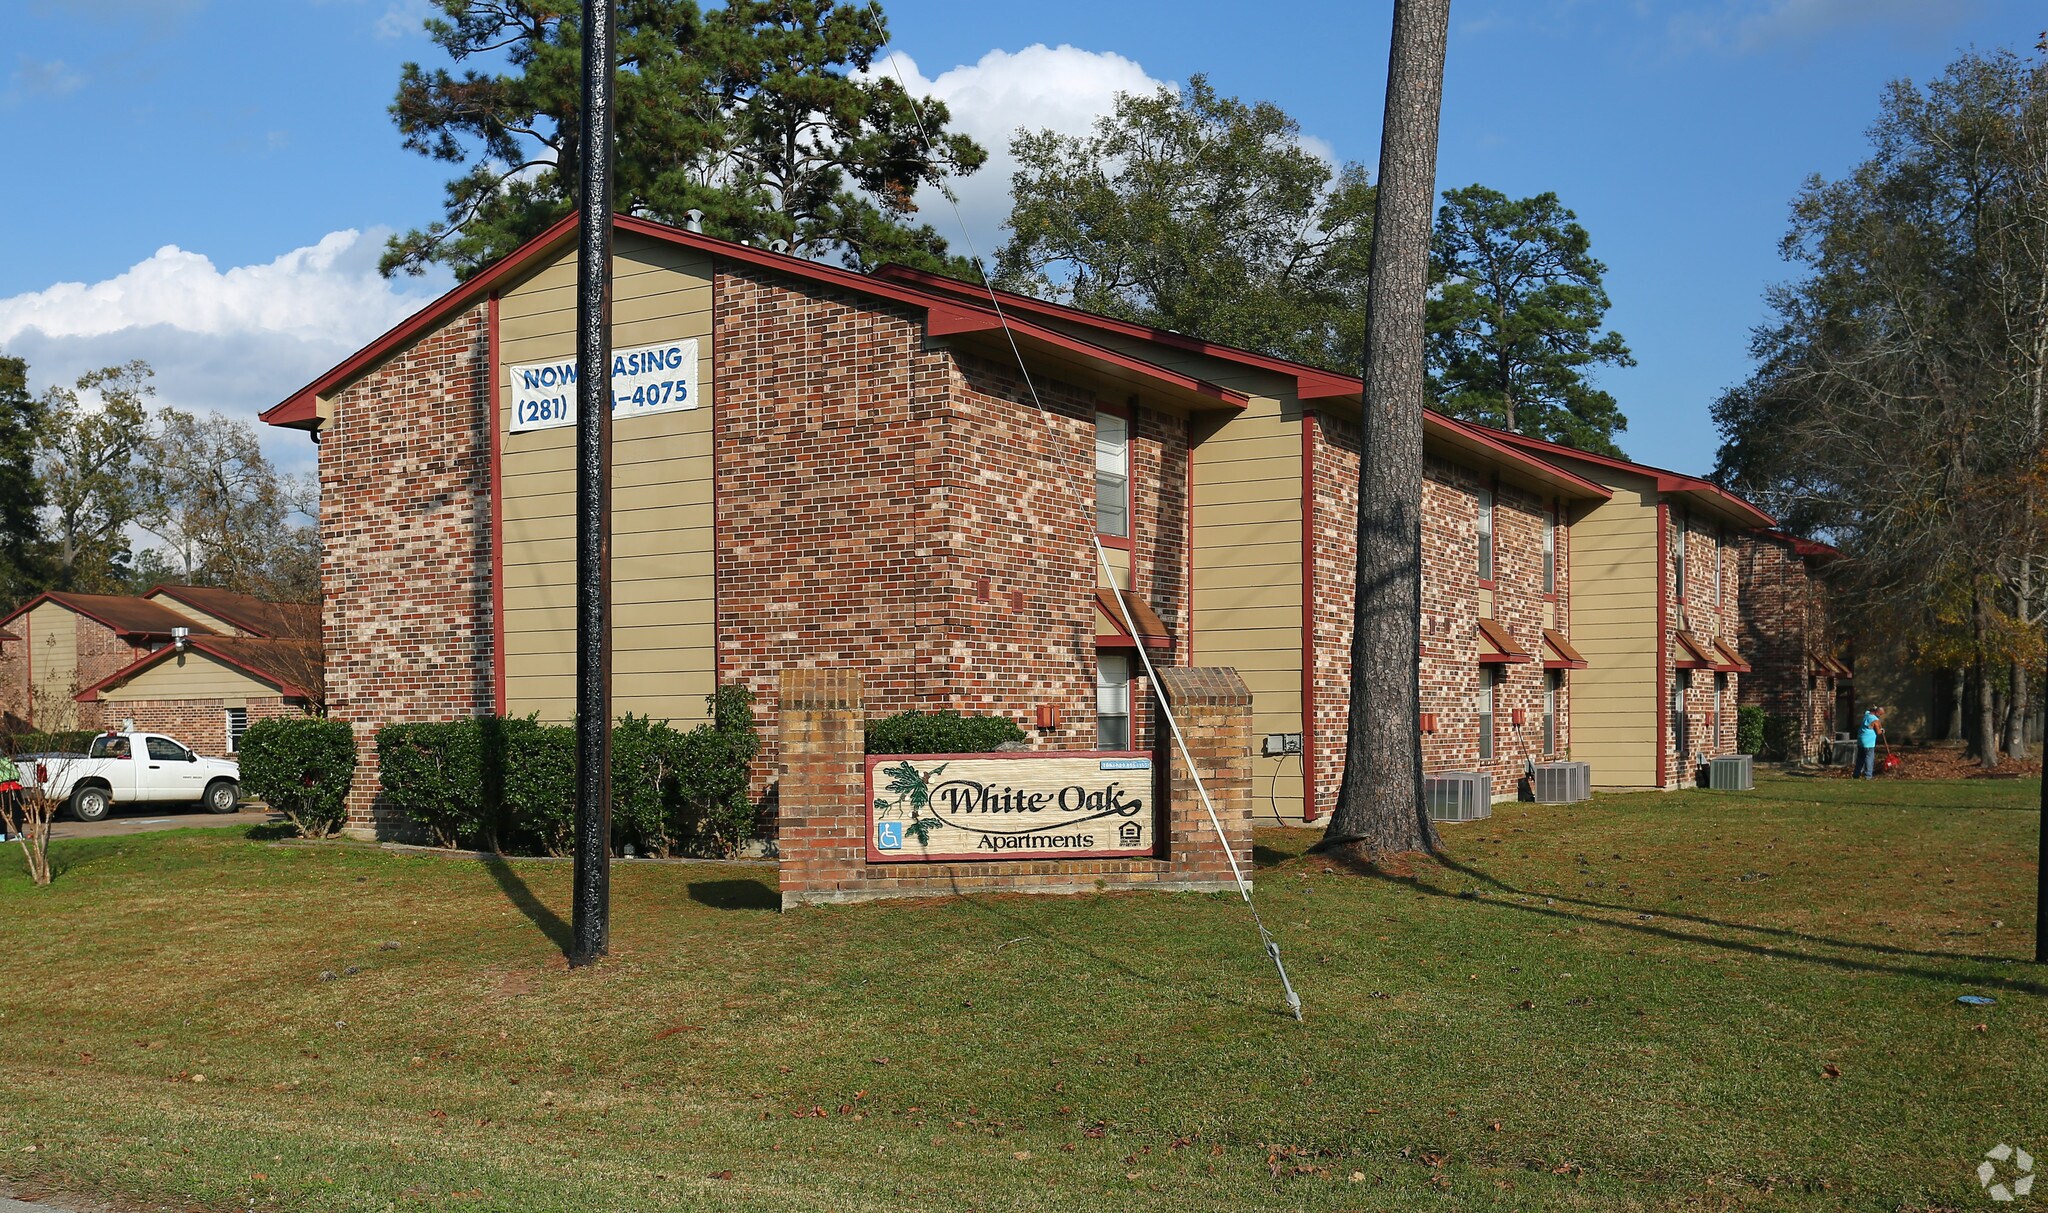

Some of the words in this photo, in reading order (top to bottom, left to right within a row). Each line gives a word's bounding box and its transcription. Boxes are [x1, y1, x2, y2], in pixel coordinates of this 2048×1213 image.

[524, 363, 577, 390] NOW
[611, 347, 682, 377] ASING
[518, 394, 567, 424] (281)
[611, 380, 687, 411] -4075
[941, 780, 1054, 814] White
[1058, 782, 1143, 816] Oak
[977, 833, 1094, 852] Apartments
